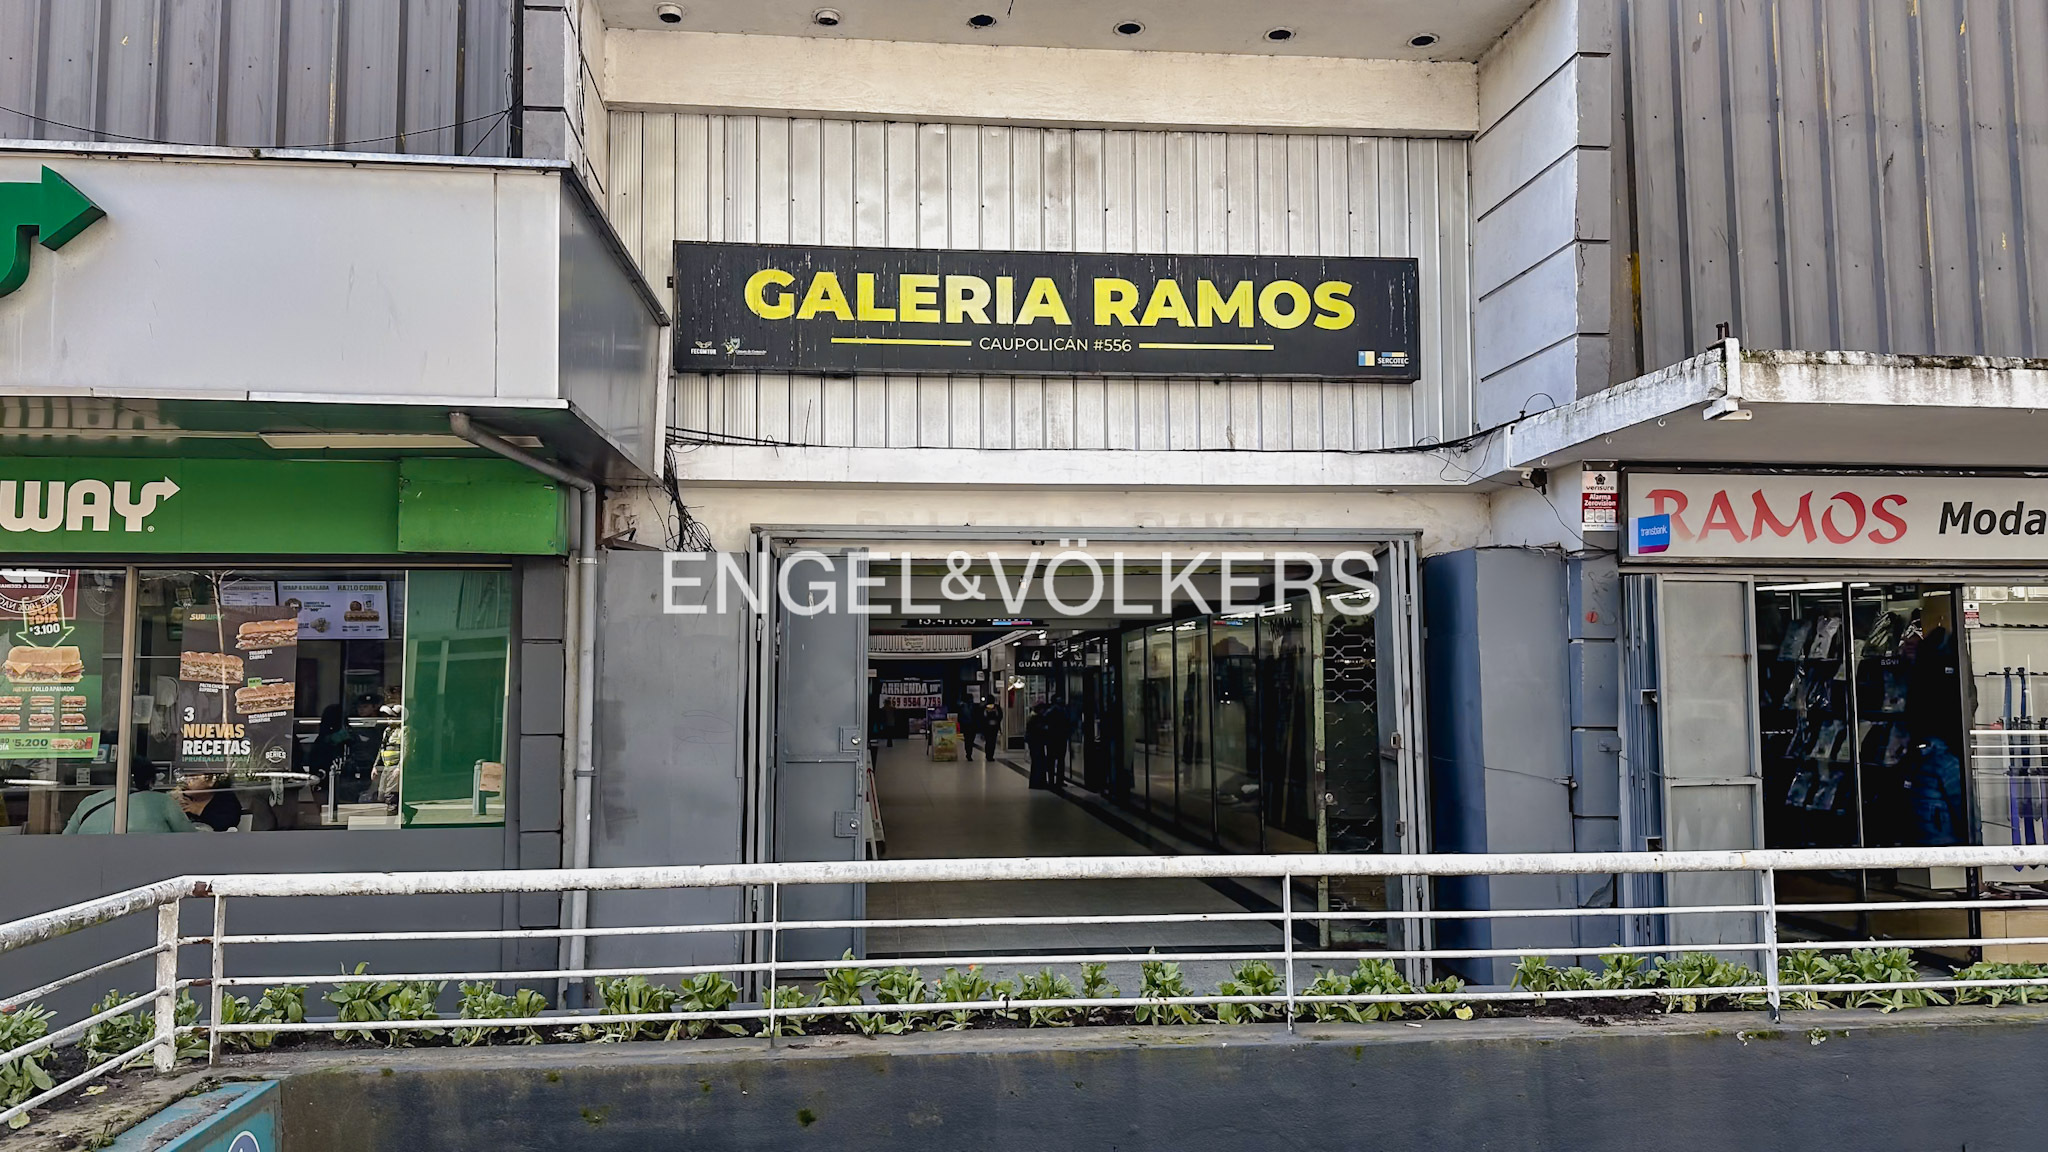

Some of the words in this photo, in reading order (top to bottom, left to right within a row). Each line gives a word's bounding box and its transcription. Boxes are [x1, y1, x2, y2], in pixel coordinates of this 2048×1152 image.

[743, 268, 1073, 326] GALERIA
[1093, 277, 1357, 331] RAMOS
[979, 335, 1088, 351] CAUPOLICÁN
[1093, 338, 1132, 352] #556
[1377, 357, 1410, 365] SERCOTEC
[0, 476, 181, 532] WAY
[1589, 493, 1612, 501] Alarma
[1645, 488, 1908, 545] RAMOS
[1938, 500, 2047, 536] Moda
[881, 682, 928, 695] ARRIENDA
[183, 706, 195, 722] 3
[183, 724, 245, 738] NUEVAS
[182, 740, 251, 755] RECETAS
[265, 751, 286, 760] SERIES
